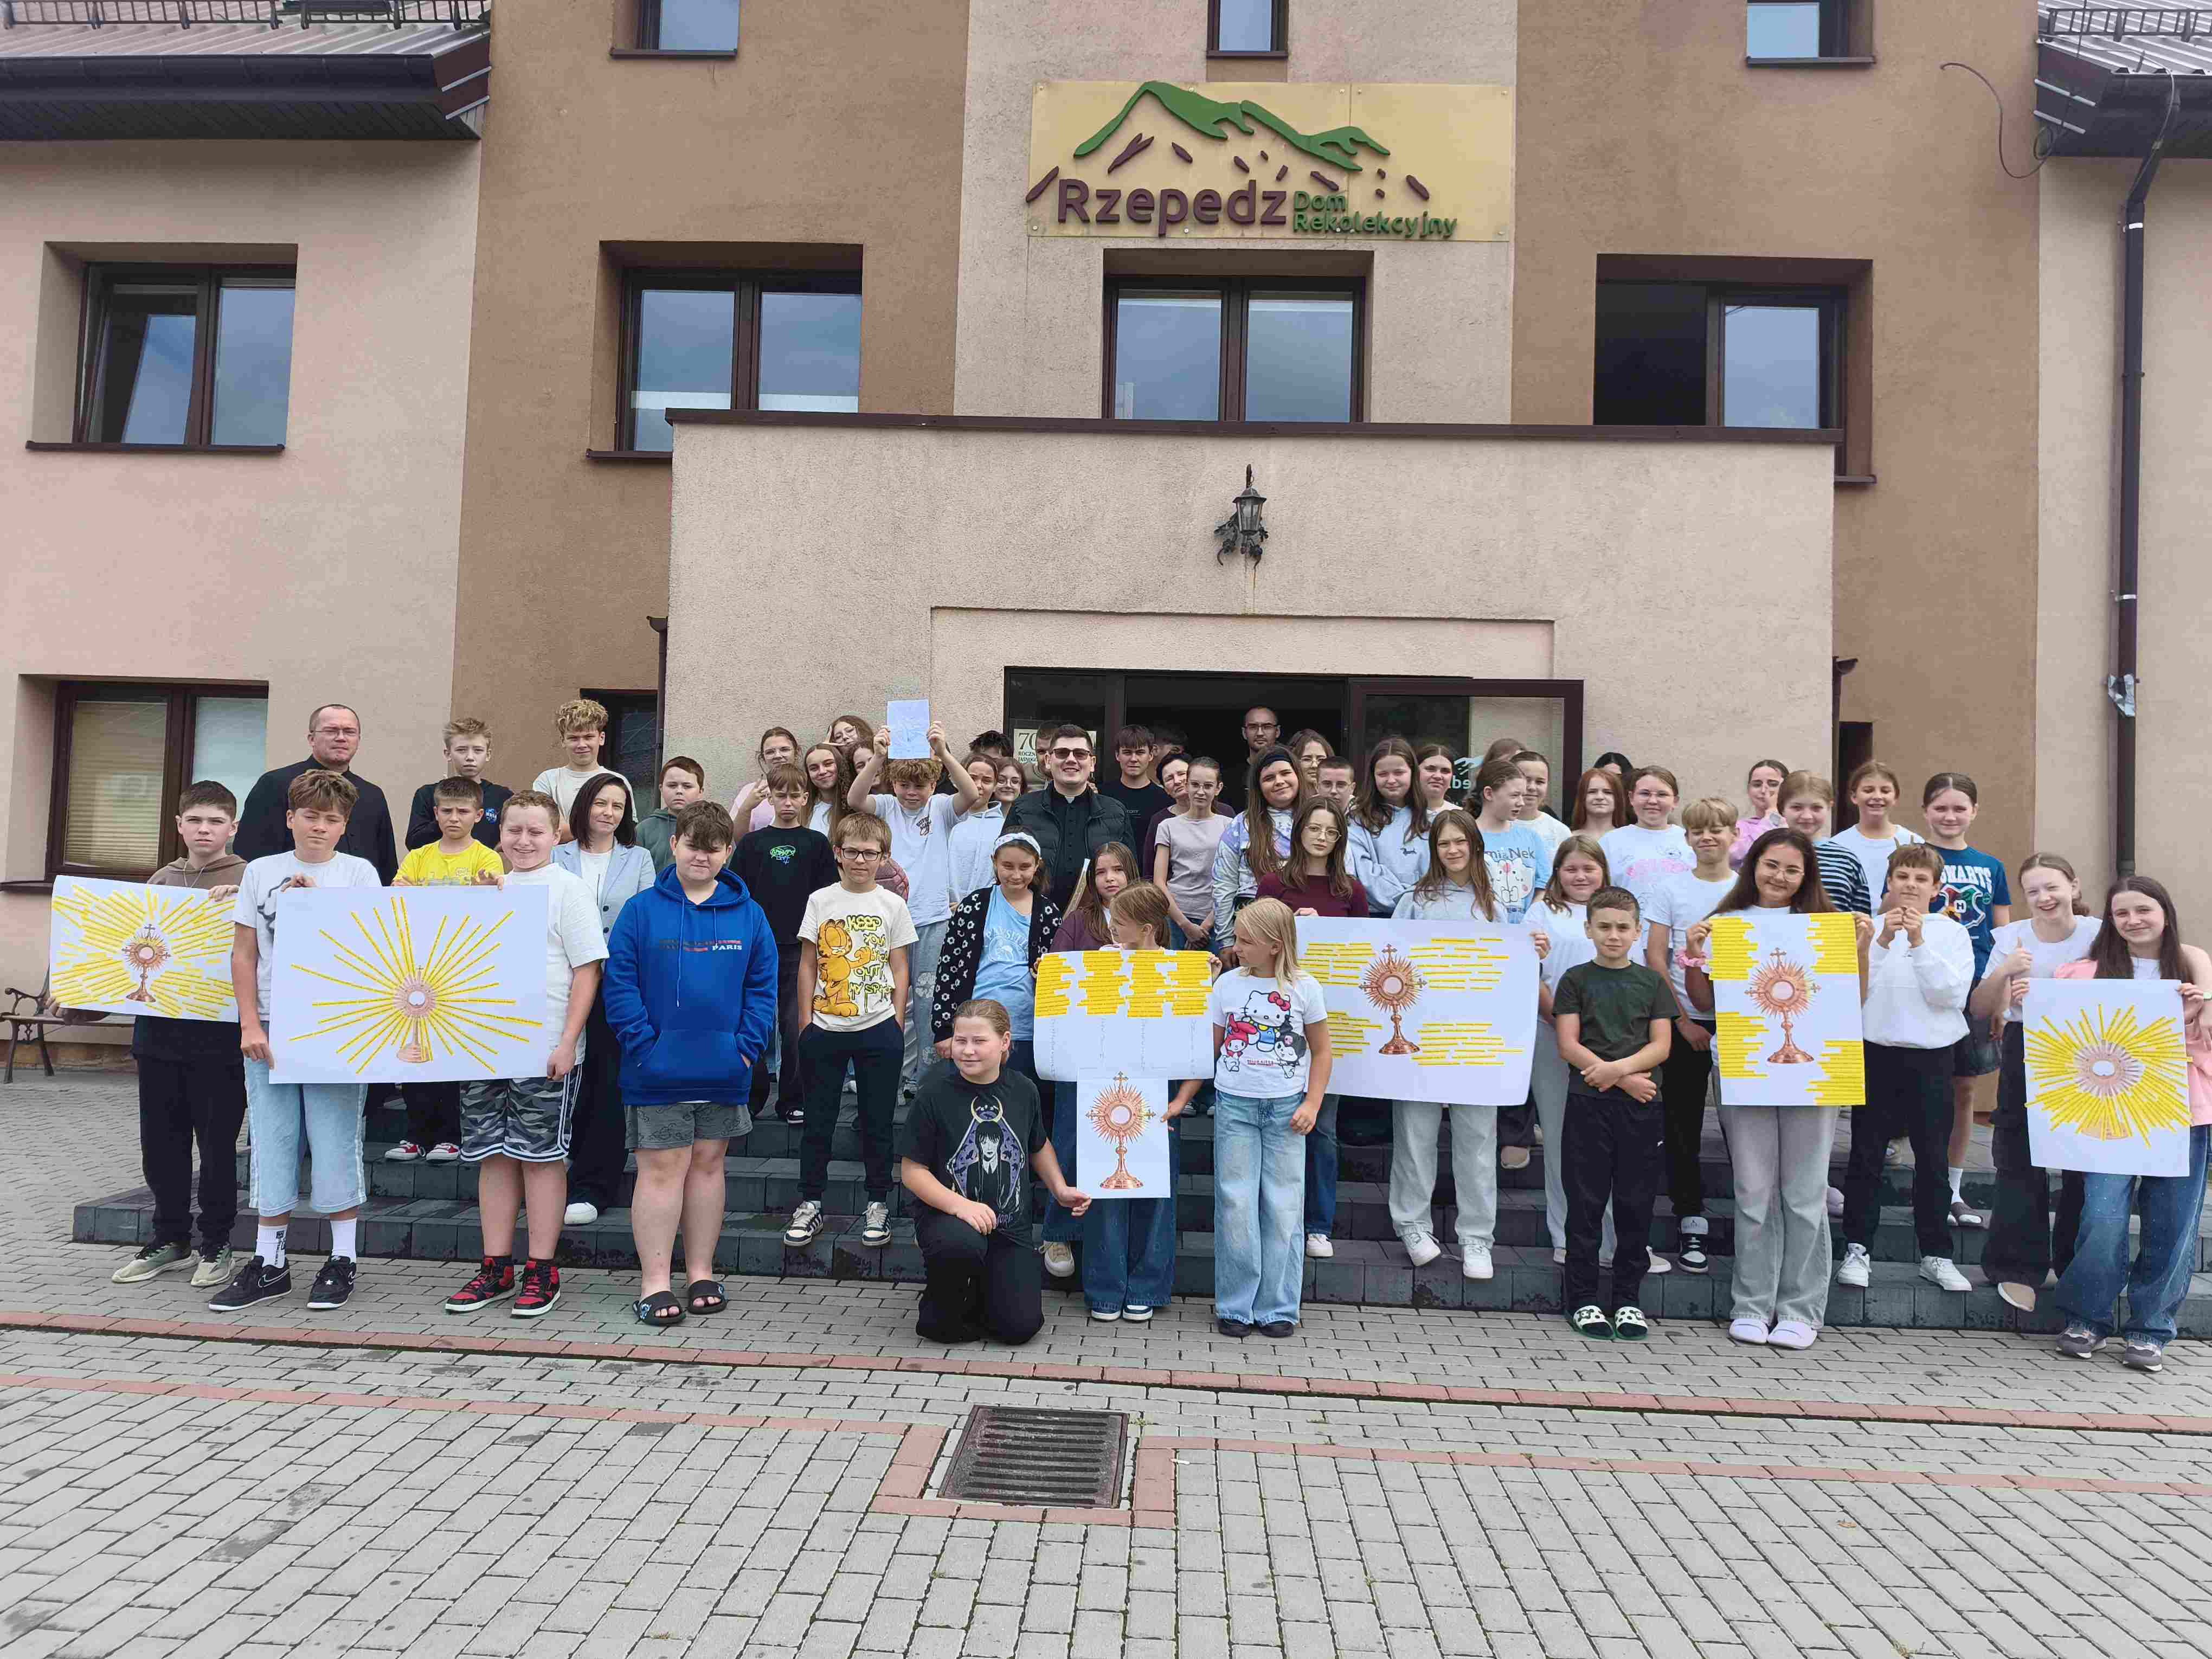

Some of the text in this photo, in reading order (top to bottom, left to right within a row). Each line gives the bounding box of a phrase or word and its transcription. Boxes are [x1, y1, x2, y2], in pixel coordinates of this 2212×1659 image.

[1058, 165, 1288, 237] Rzepedź
[1294, 190, 1346, 211] Dom
[1293, 210, 1458, 239] Rekolekcyjny
[846, 915, 883, 931] KEEP
